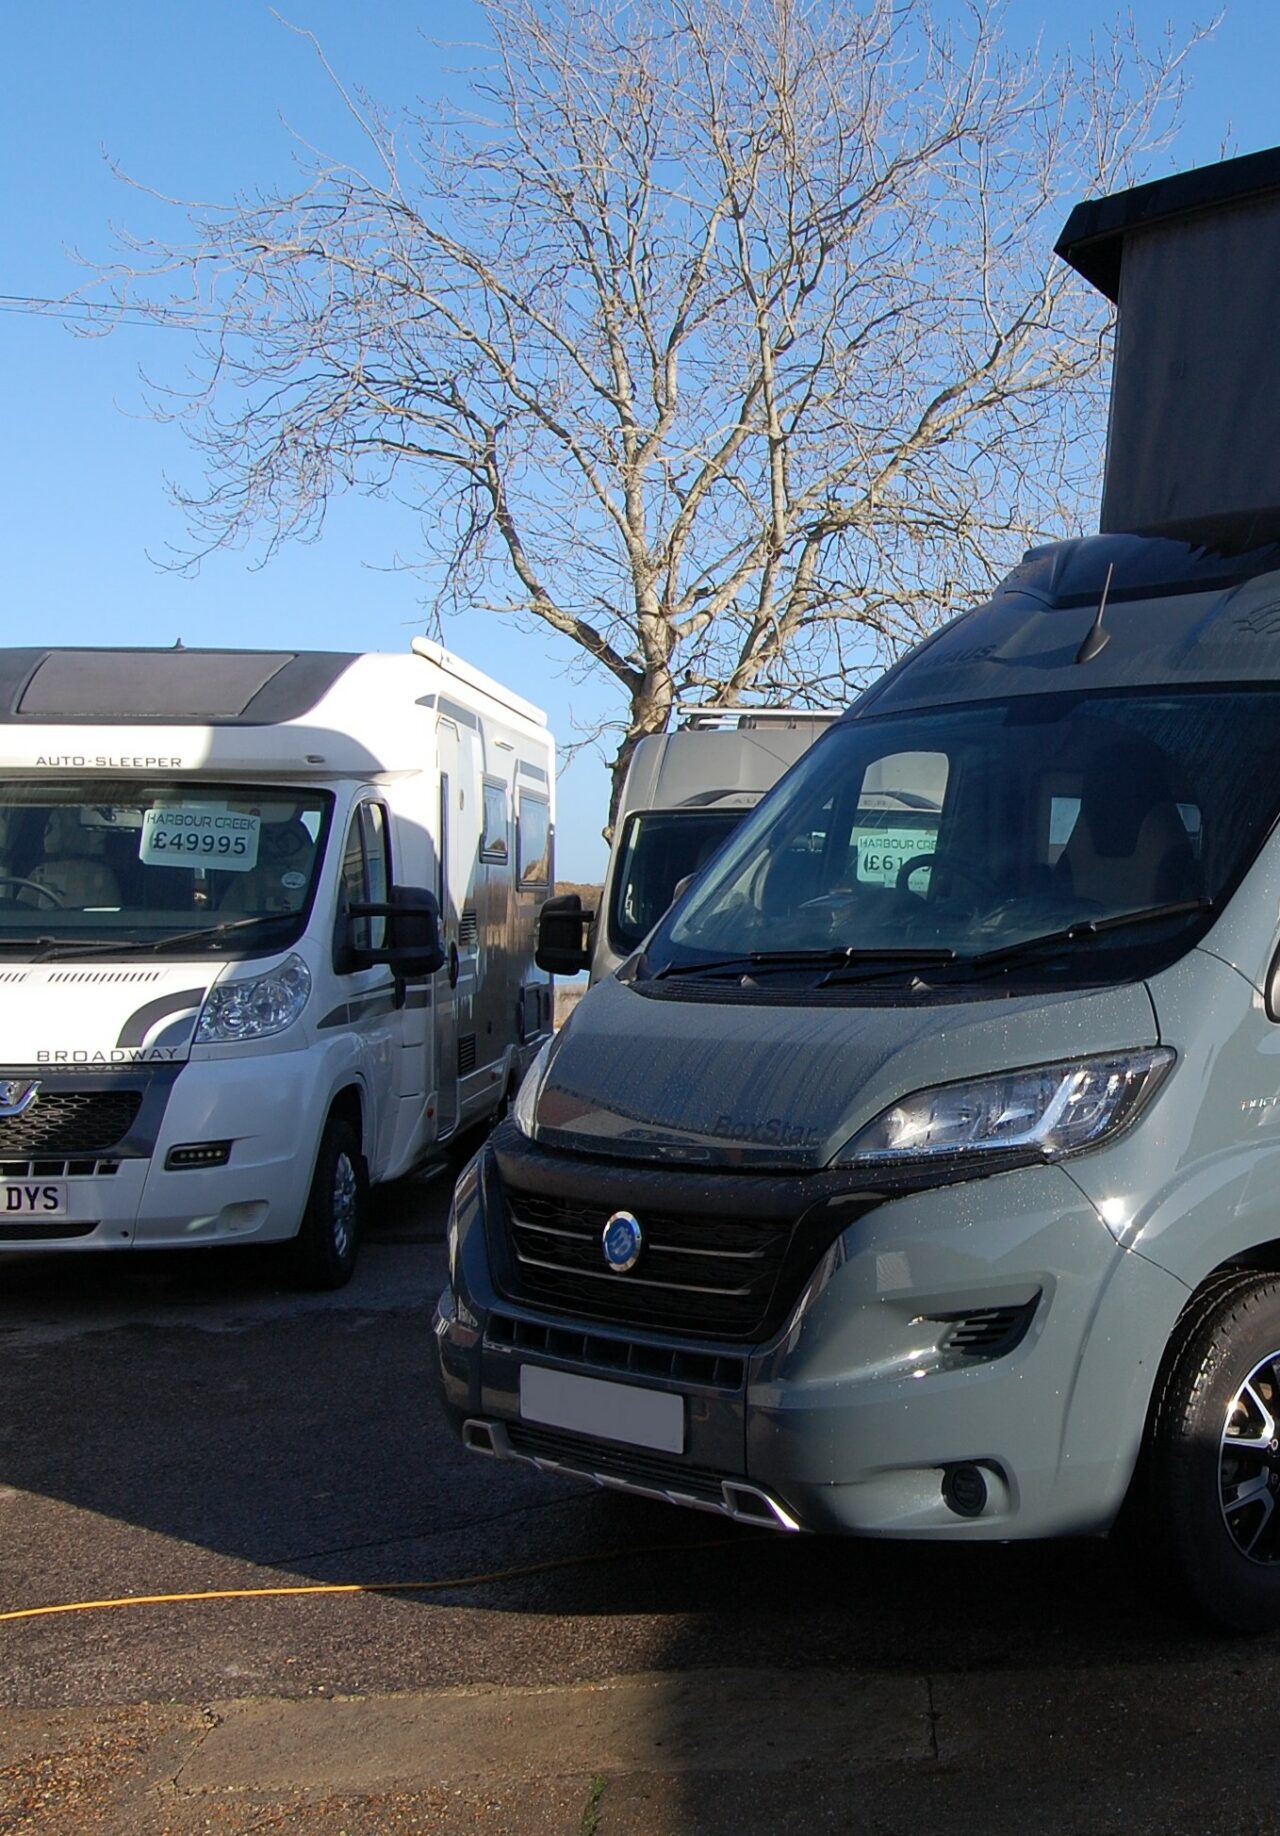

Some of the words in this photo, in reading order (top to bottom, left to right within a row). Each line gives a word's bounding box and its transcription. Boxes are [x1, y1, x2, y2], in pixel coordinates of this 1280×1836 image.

[36, 756, 182, 768] AUTO-SLEEPER
[146, 812, 212, 828] HARBOUR
[214, 816, 257, 831] CREEK
[152, 831, 247, 855] £49995
[860, 838, 914, 850] HARBOUR
[916, 840, 937, 850] CRE
[36, 1048, 178, 1062] BROADWAY
[6, 1186, 59, 1211] DYS
